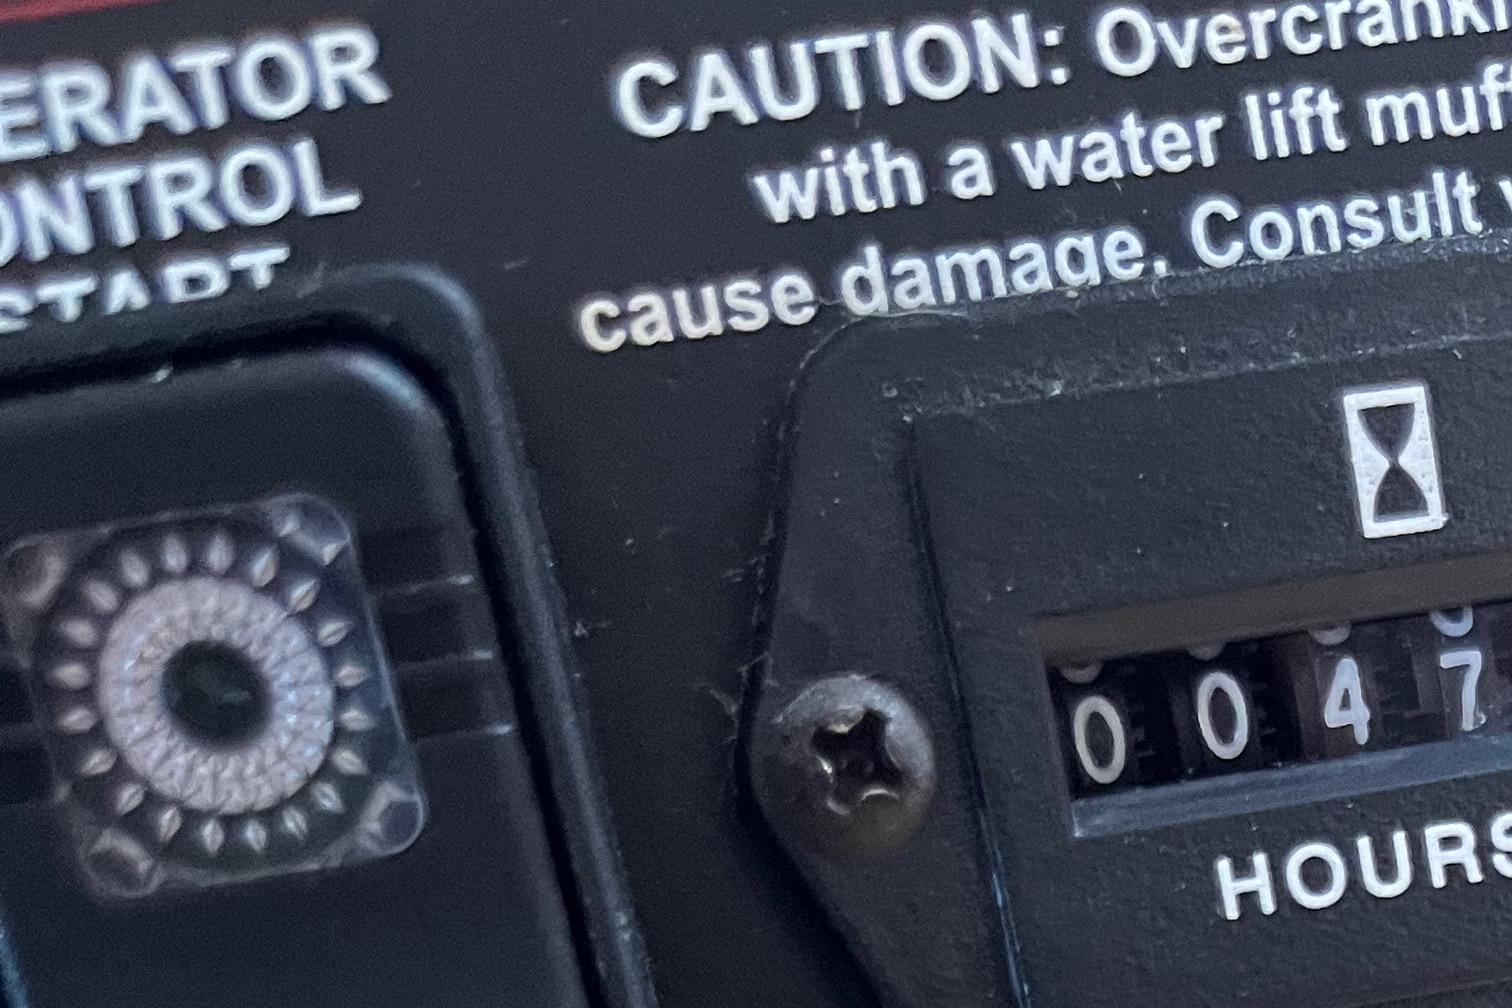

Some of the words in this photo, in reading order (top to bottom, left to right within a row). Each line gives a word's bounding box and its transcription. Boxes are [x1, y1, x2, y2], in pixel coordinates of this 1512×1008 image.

[616, 12, 1068, 138] CAUTION:
[0, 139, 361, 267] NTROL
[752, 140, 925, 223] with
[946, 145, 994, 200] a
[1010, 111, 1224, 190] water
[1244, 84, 1348, 161] lift
[579, 273, 816, 352] cause
[840, 228, 1170, 316] damage.
[1190, 169, 1484, 269] Consult
